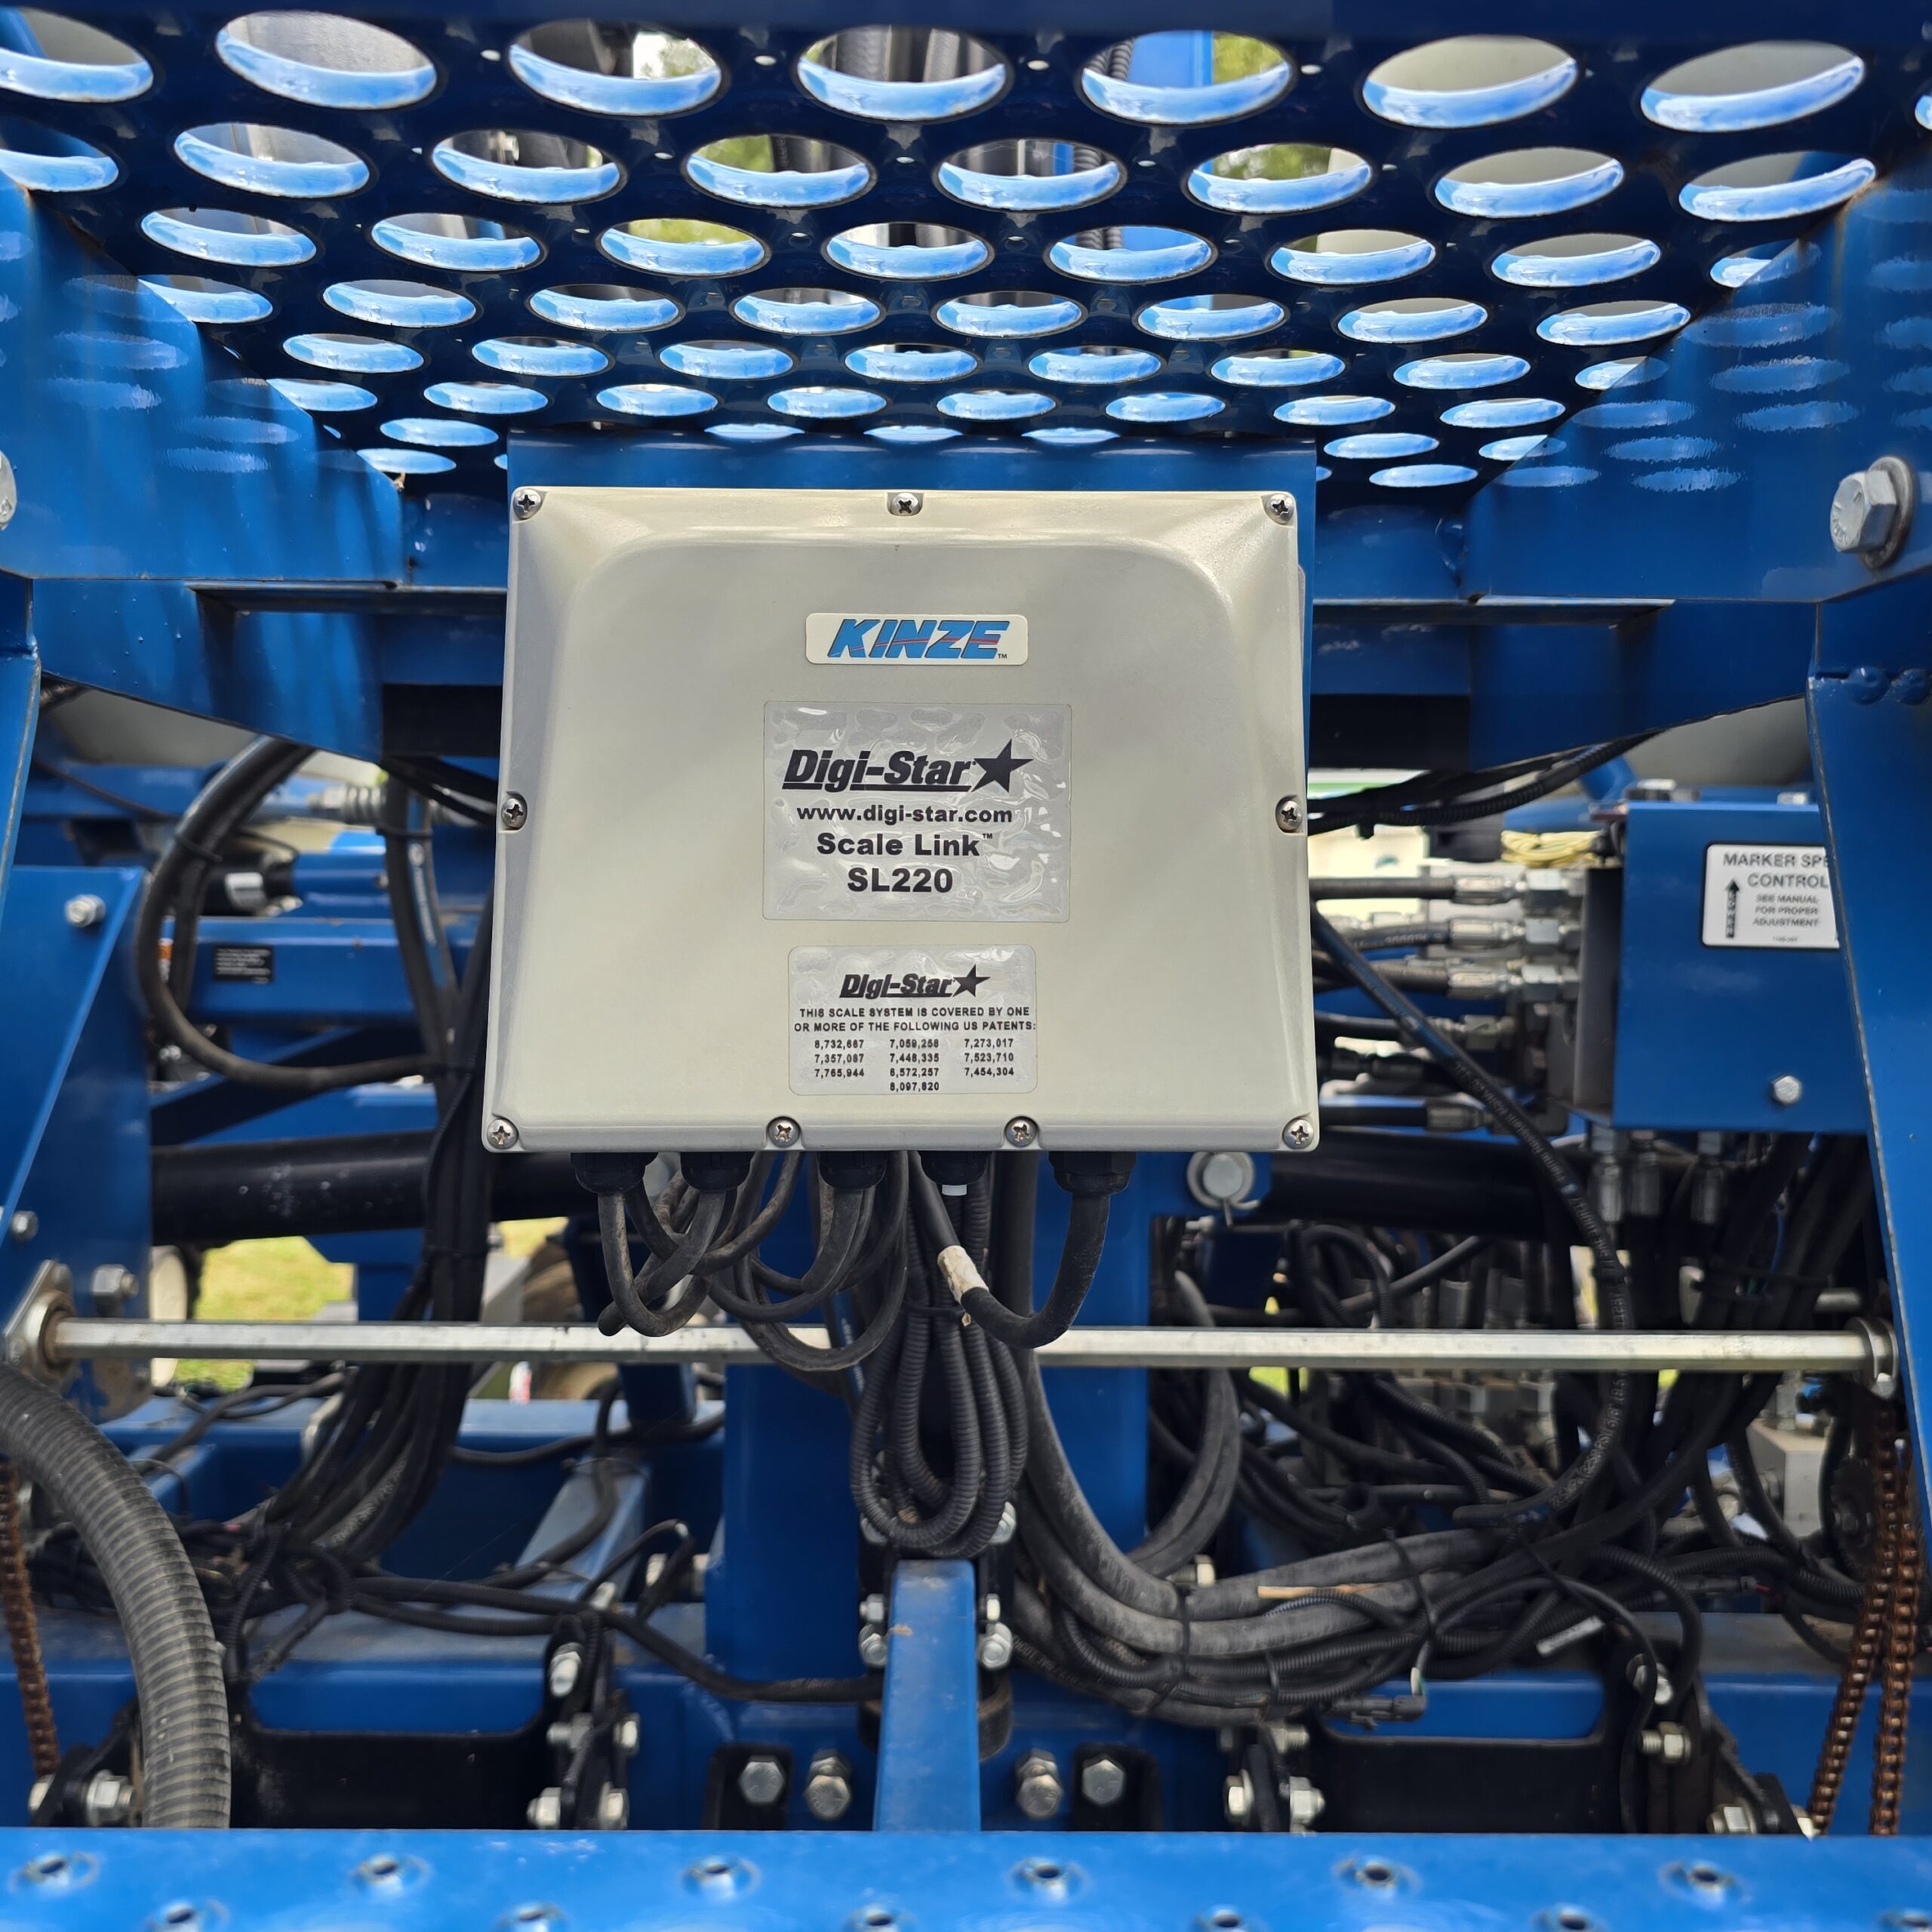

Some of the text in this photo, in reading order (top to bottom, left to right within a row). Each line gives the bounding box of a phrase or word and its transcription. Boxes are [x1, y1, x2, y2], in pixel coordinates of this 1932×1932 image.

[827, 618, 1011, 660] KINZE
[783, 749, 974, 792] Digi-Star
[797, 804, 1012, 825] www.digi-star.com
[817, 833, 903, 855] Scale
[915, 833, 980, 856] Link
[1723, 853, 1795, 867] MARKER
[848, 868, 953, 893] SL220
[1747, 873, 1829, 888] CONTROL
[1777, 894, 1818, 903] MANUAL
[1755, 906, 1818, 915] FOR PROPER
[1752, 918, 1819, 927] ADJUSTMENT
[839, 973, 952, 999] Digi-Star
[800, 1007, 1029, 1017] THIS SCALE SYSTEM IS COVERED BY ONE
[794, 1021, 1035, 1032] OR MORE OF THE FOLLOWING US PATENTS:
[964, 1038, 1014, 1049] 7,273,017
[964, 1053, 1014, 1063] 7,523,710
[964, 1067, 1014, 1078] 7,454,304
